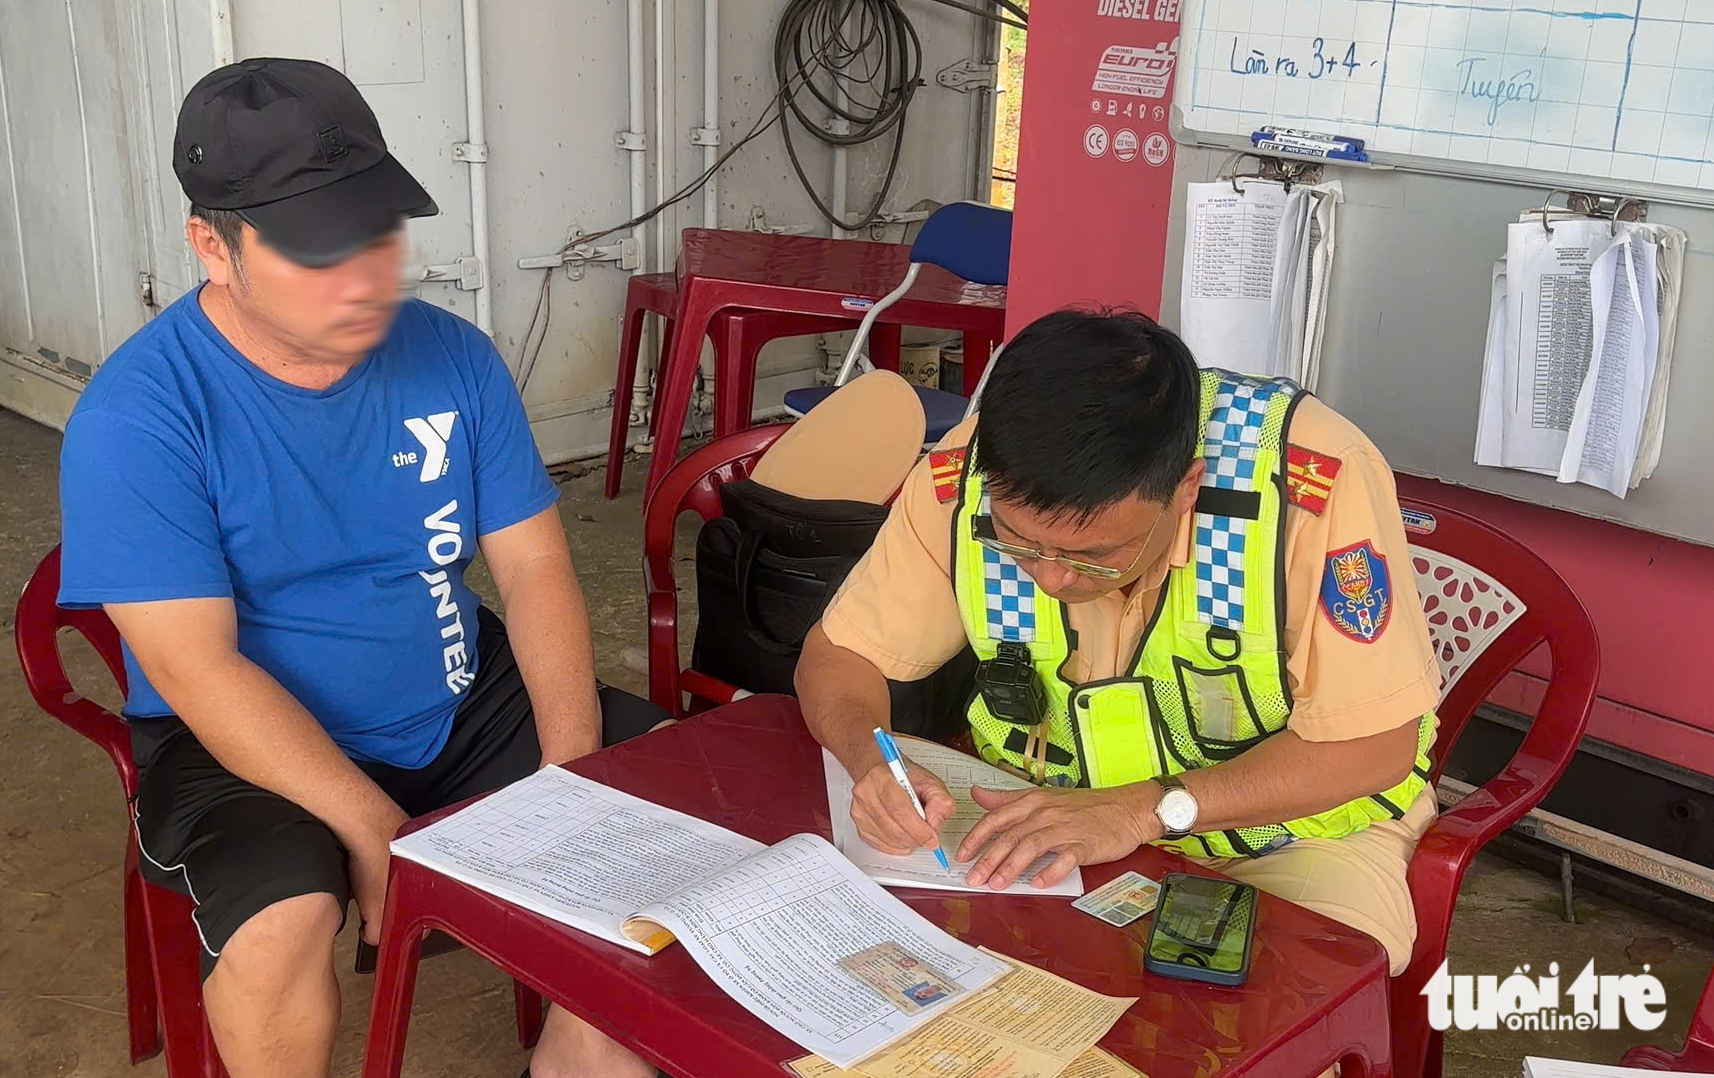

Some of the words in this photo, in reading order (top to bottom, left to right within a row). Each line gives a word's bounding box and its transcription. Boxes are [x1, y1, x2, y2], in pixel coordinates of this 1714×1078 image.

[1097, 0, 1150, 20] DIESEL
[1112, 73, 1128, 81] FUEL
[1275, 58, 1298, 78] ra
[392, 451, 418, 468] the
